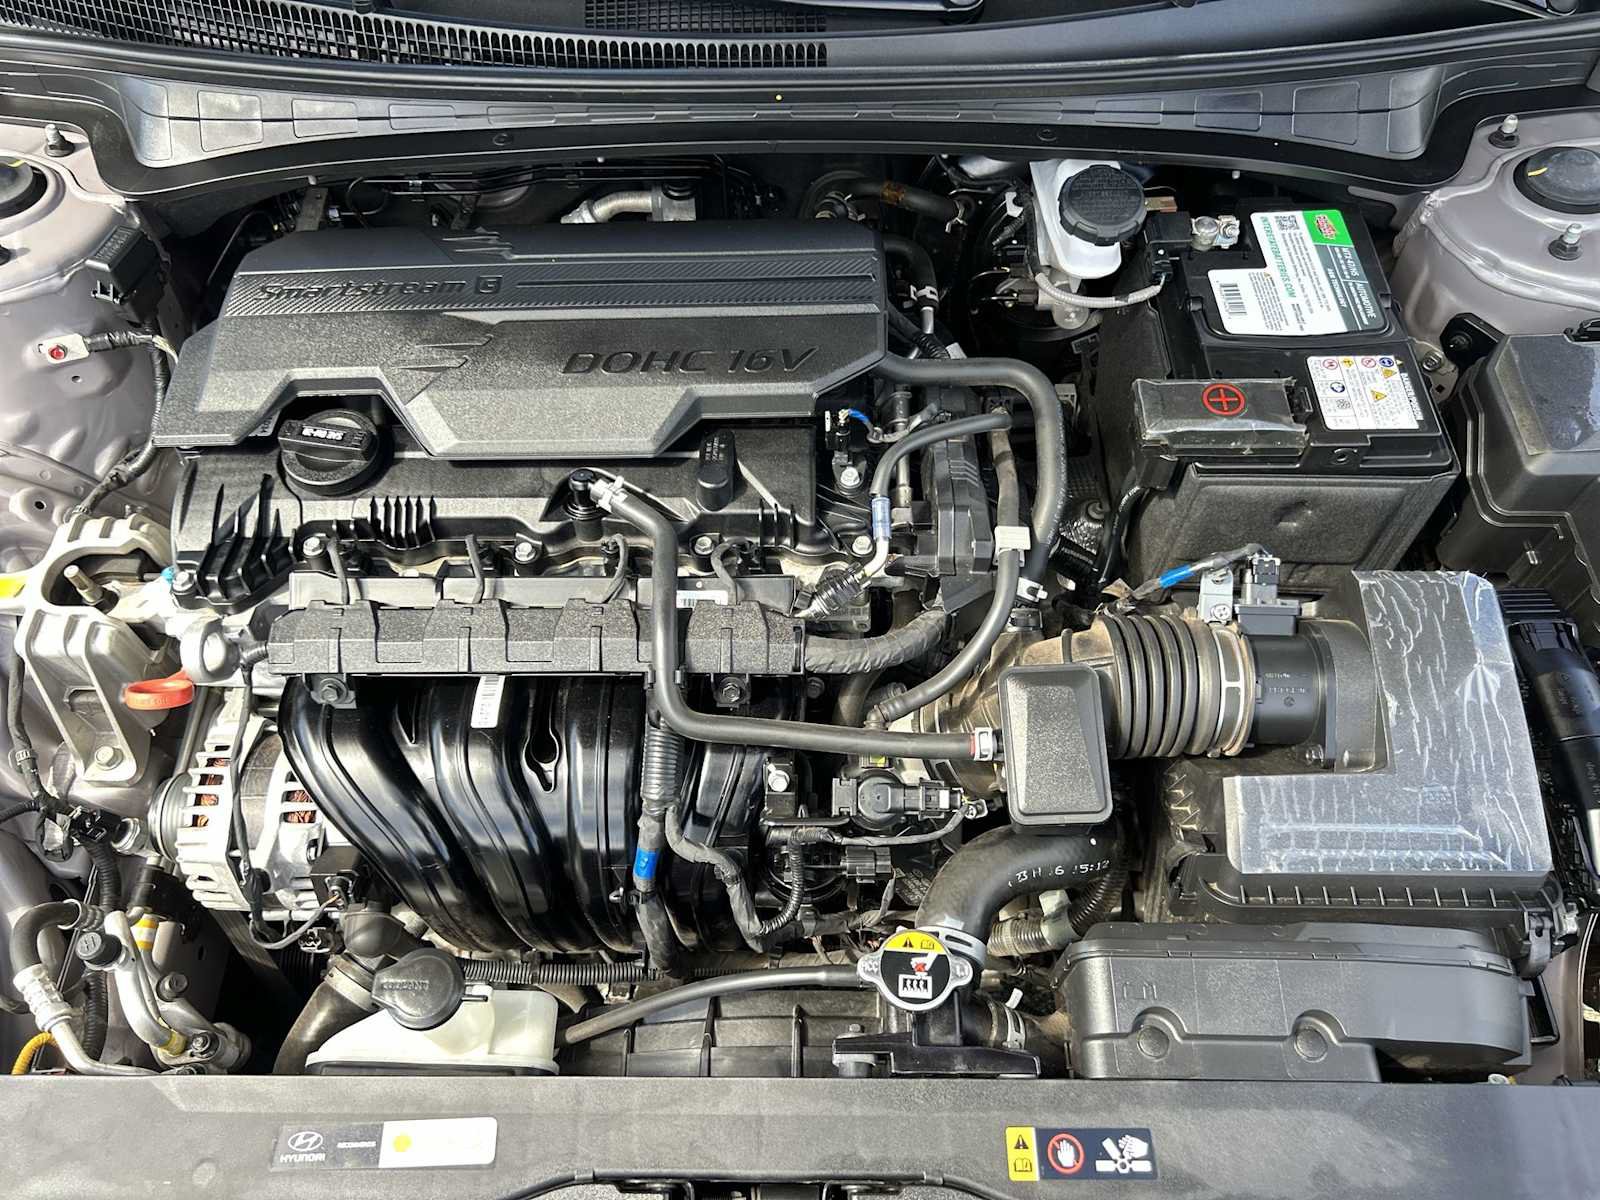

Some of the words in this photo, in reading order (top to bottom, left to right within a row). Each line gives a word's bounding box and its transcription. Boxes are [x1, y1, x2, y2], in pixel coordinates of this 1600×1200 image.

[257, 279, 467, 300] Smartstream
[558, 351, 715, 374] DOHC
[727, 347, 819, 373] 16V
[280, 1152, 326, 1163] HYUNDAI
